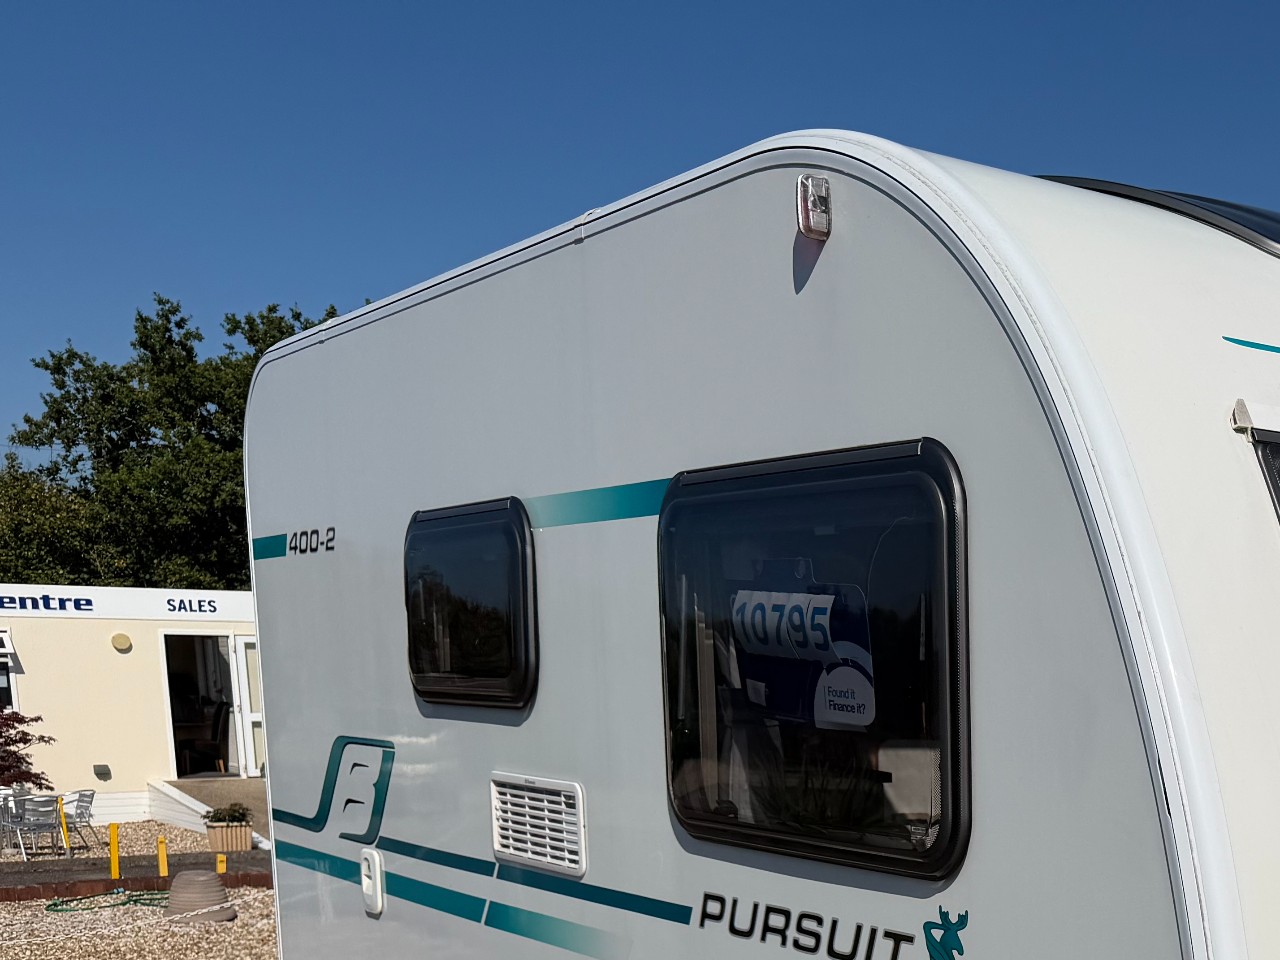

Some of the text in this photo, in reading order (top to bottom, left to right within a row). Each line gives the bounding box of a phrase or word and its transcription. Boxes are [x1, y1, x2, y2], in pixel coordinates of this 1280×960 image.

[289, 526, 336, 556] 400-2
[0, 594, 94, 611] entre
[166, 598, 218, 613] SALES
[735, 602, 830, 652] 10795
[827, 686, 856, 700] Found it
[828, 700, 866, 715] Finance it?
